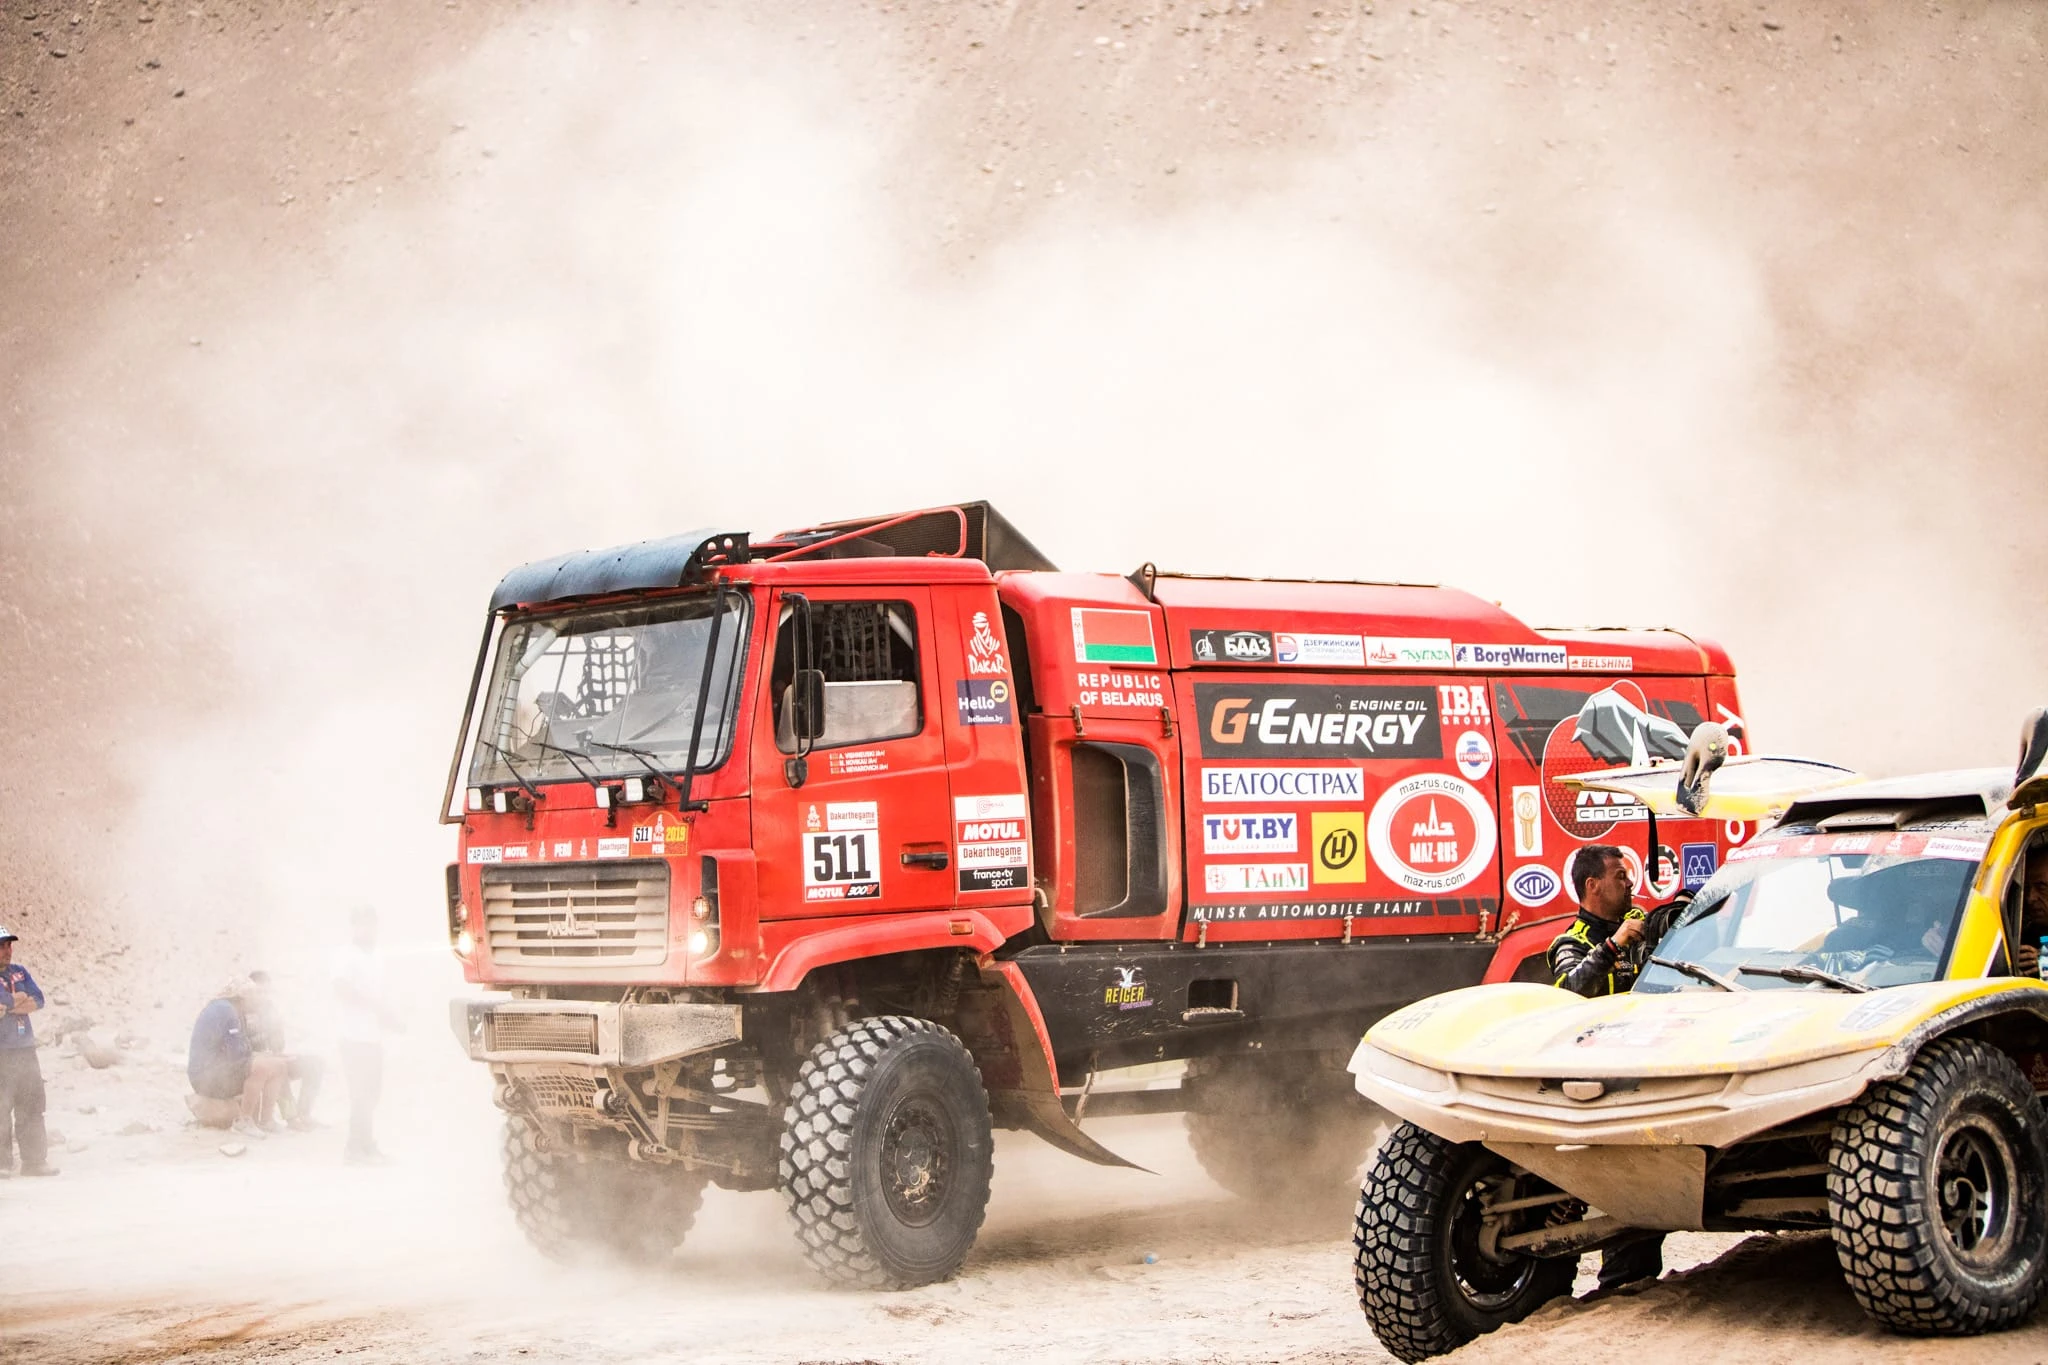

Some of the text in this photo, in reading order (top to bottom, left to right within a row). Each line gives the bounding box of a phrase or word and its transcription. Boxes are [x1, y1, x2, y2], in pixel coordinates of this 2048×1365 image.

[1224, 636, 1272, 657] БААЗ
[968, 653, 1008, 674] DAKAR
[1474, 645, 1566, 667] BorgWarner
[1581, 658, 1632, 670] BELSHINA
[1078, 673, 1161, 689] REPUBLIC
[958, 696, 996, 711] Hello
[1080, 691, 1164, 707] OF BELARUS
[1349, 699, 1428, 711] ENGINE OIL
[1438, 685, 1490, 716] IBA
[967, 714, 1004, 724] hellosim.by
[1442, 716, 1491, 727] GROUP
[1207, 772, 1358, 796] БЕЛГОССТРАХ
[1399, 779, 1465, 796] maz-rus.com
[829, 811, 875, 822] Dakarthegame
[635, 827, 650, 842] 511
[665, 826, 686, 842] 2019
[963, 821, 1021, 841] MOTUL
[1206, 817, 1293, 841] TUT.BY
[813, 834, 871, 882] 511
[963, 846, 1022, 859] Dakarthegame
[1409, 841, 1459, 864] MAZ-RUS
[991, 877, 1014, 889] sport
[1403, 872, 1466, 889] maz-rus.com
[807, 884, 879, 899] MOTUL 300V
[1193, 901, 1422, 920] MINSK AUTOMOBILE PLANT
[1105, 986, 1145, 1005] REIGER
